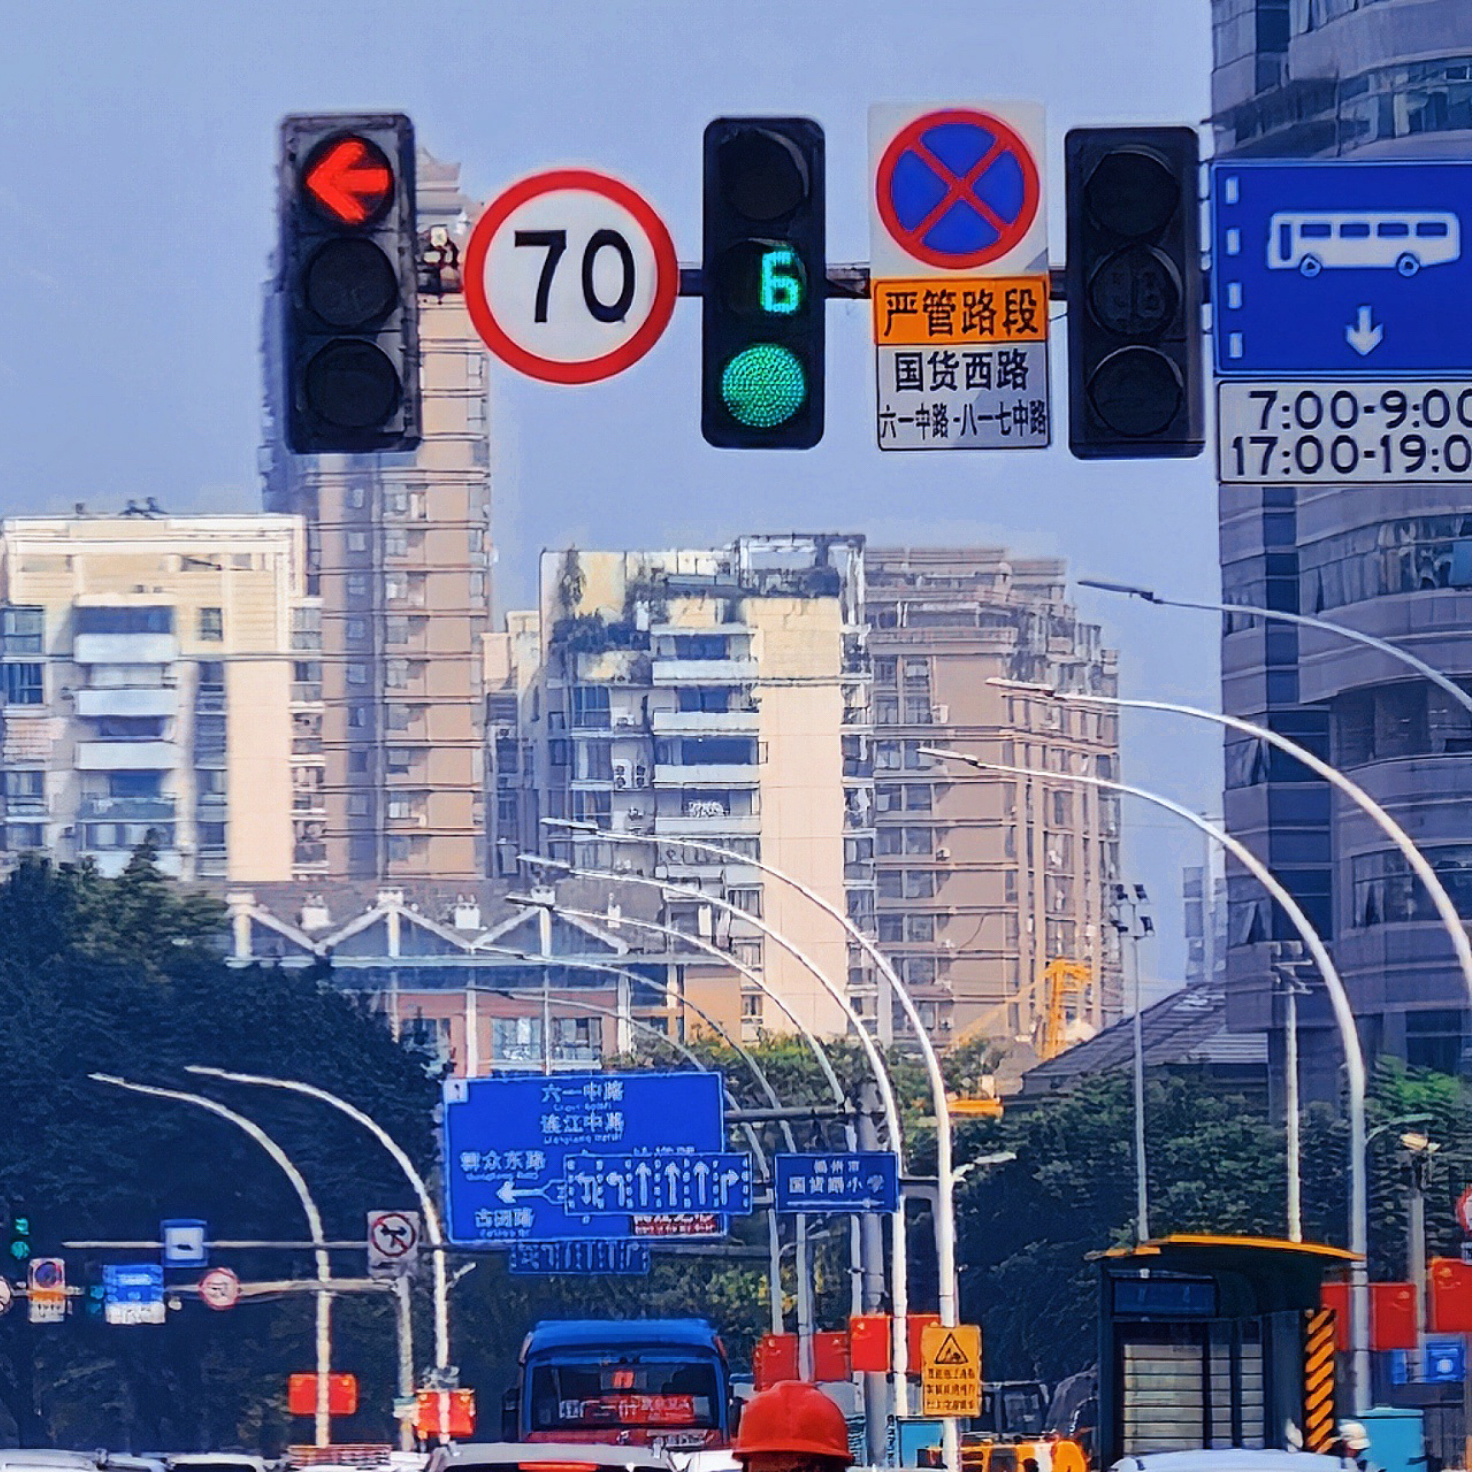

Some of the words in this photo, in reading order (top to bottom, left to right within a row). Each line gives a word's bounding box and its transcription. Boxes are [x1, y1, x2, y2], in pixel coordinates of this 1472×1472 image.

[514, 229, 635, 323] 70
[761, 251, 800, 313] 6
[884, 289, 1039, 337] 严管路段
[895, 349, 1029, 392] 国货西路
